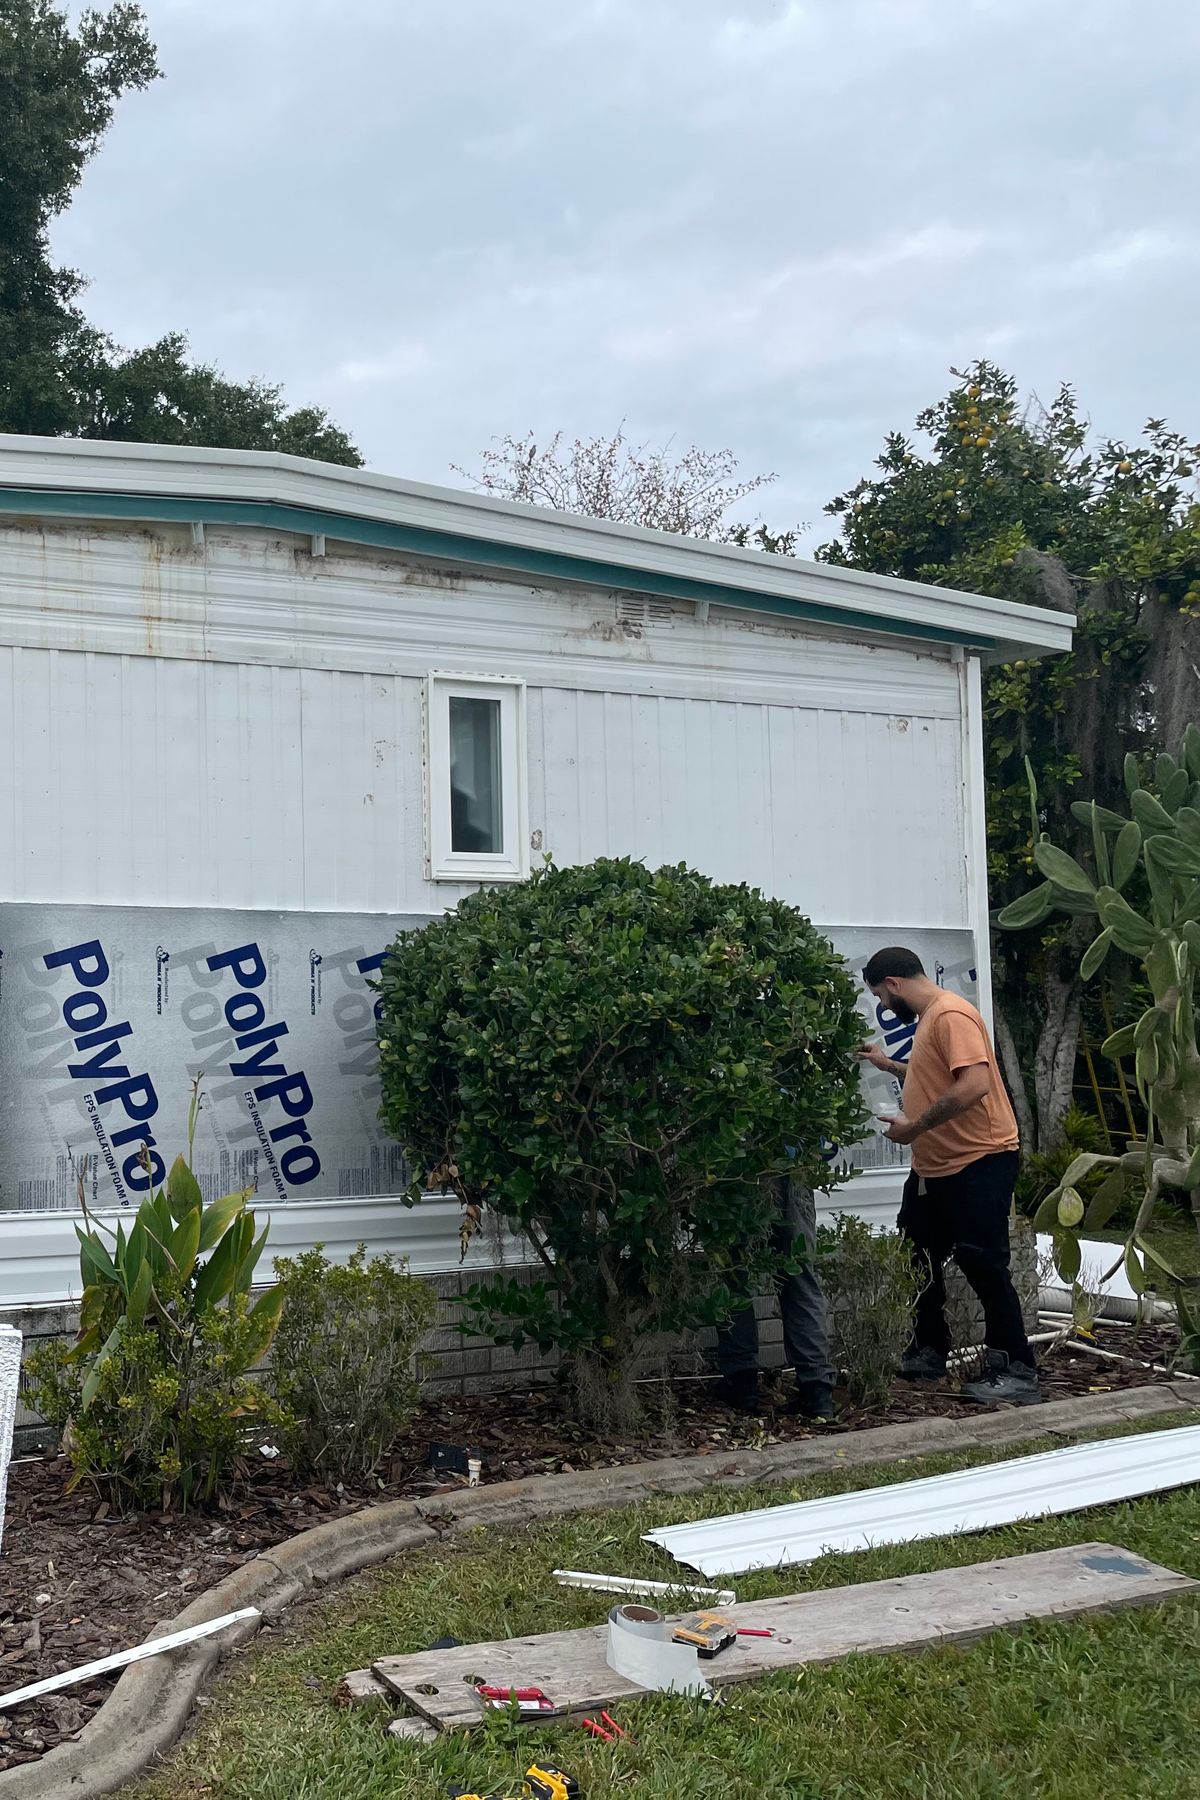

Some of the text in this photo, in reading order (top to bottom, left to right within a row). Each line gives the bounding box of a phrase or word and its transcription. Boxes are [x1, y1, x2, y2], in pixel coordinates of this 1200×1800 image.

[42, 939, 166, 1192] PolyPro
[83, 1093, 96, 1113] EPS
[90, 1114, 117, 1170] INSULATION
[110, 1170, 127, 1199] FOAM
[207, 943, 321, 1186] PolyPro
[244, 1091, 256, 1110] EPS
[250, 1110, 275, 1165] INSULATION
[270, 1165, 285, 1193] FOAM
